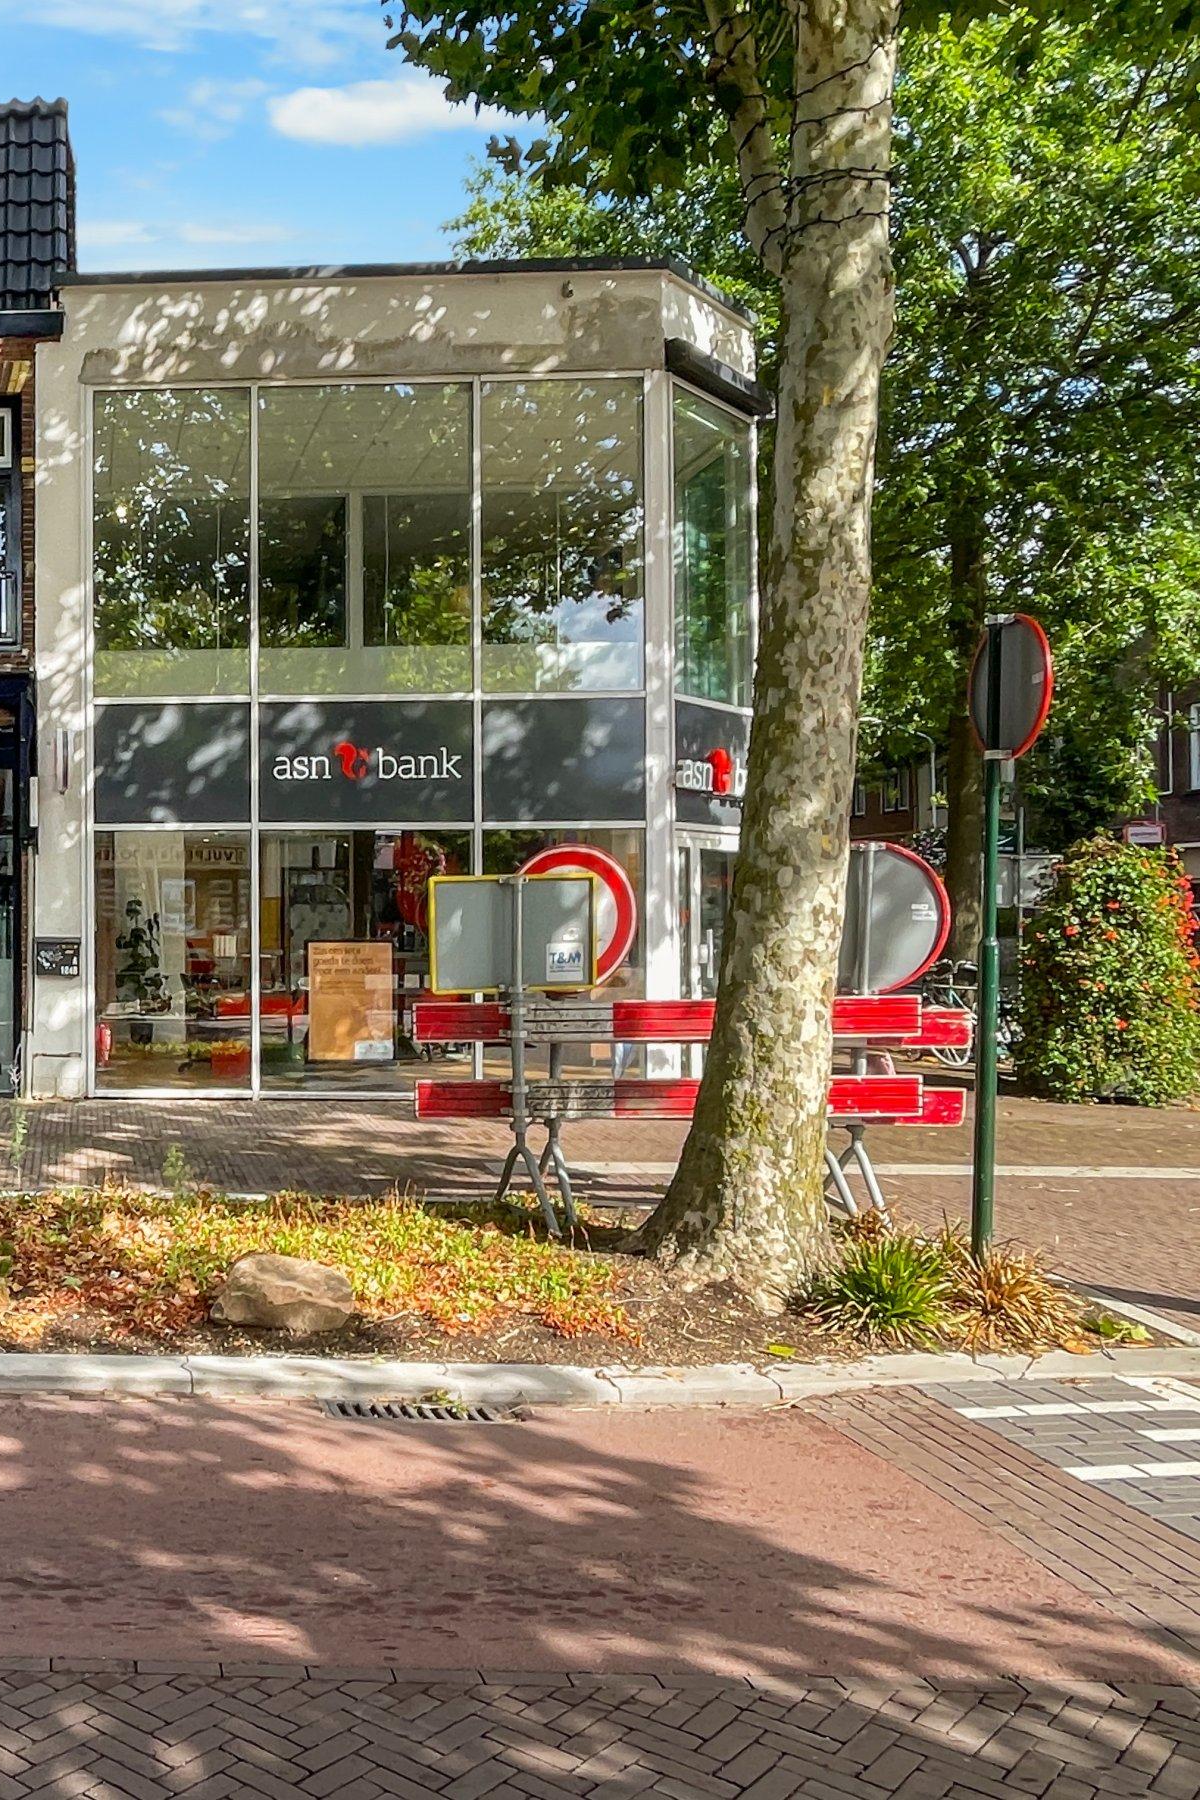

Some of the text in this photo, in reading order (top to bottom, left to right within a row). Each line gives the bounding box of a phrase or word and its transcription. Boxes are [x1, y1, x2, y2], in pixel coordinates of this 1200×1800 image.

[273, 747, 462, 780] asn bank
[677, 758, 714, 792] asn
